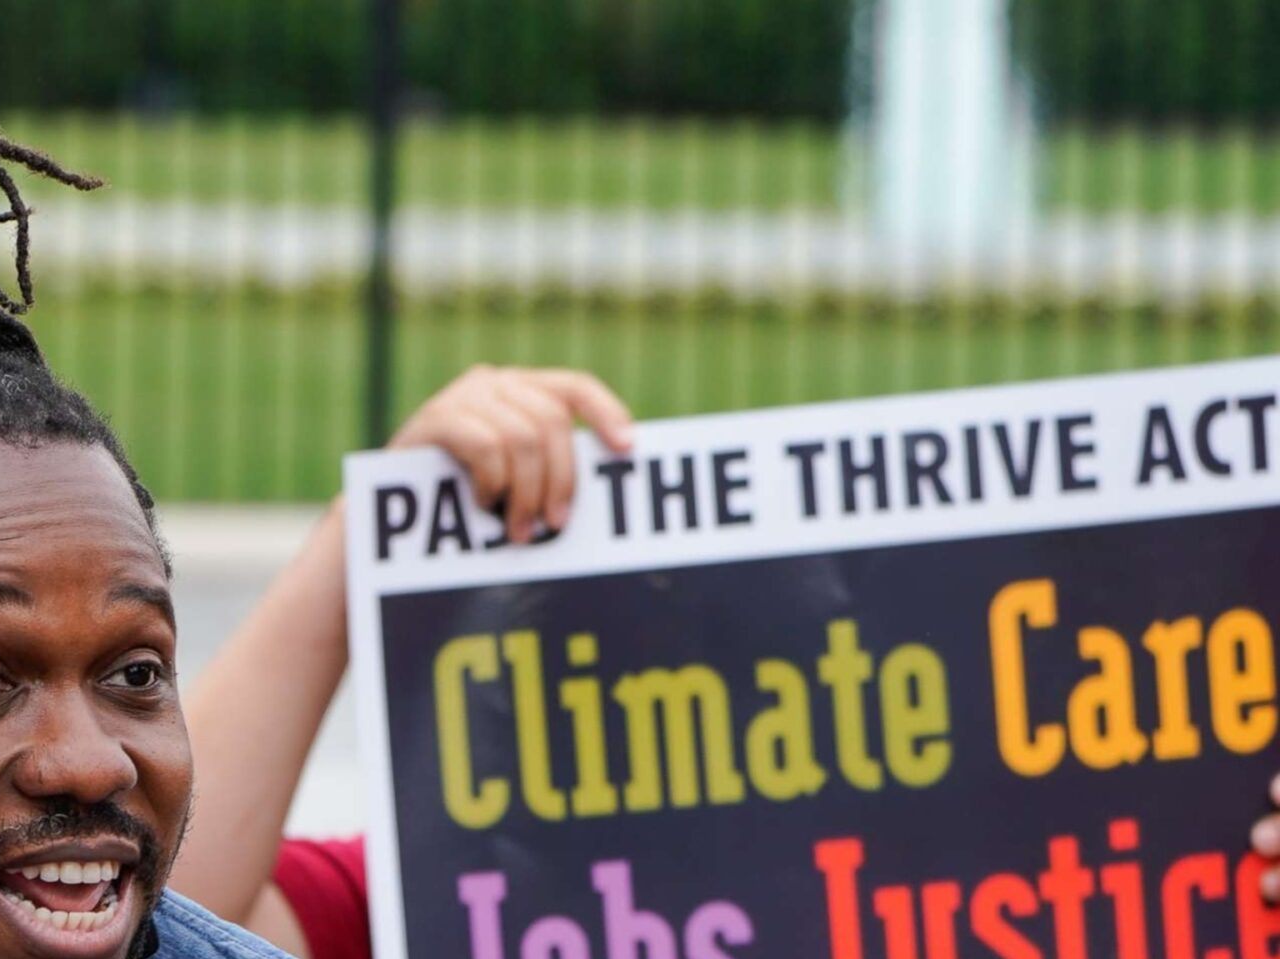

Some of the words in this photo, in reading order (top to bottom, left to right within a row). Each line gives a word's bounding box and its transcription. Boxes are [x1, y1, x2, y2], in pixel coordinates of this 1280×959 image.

[374, 476, 562, 560] PA
[596, 450, 754, 539] THE
[786, 413, 1098, 519] THRIVE
[1137, 394, 1277, 485] ACT
[434, 619, 953, 830] Climate
[988, 578, 1280, 778] Care
